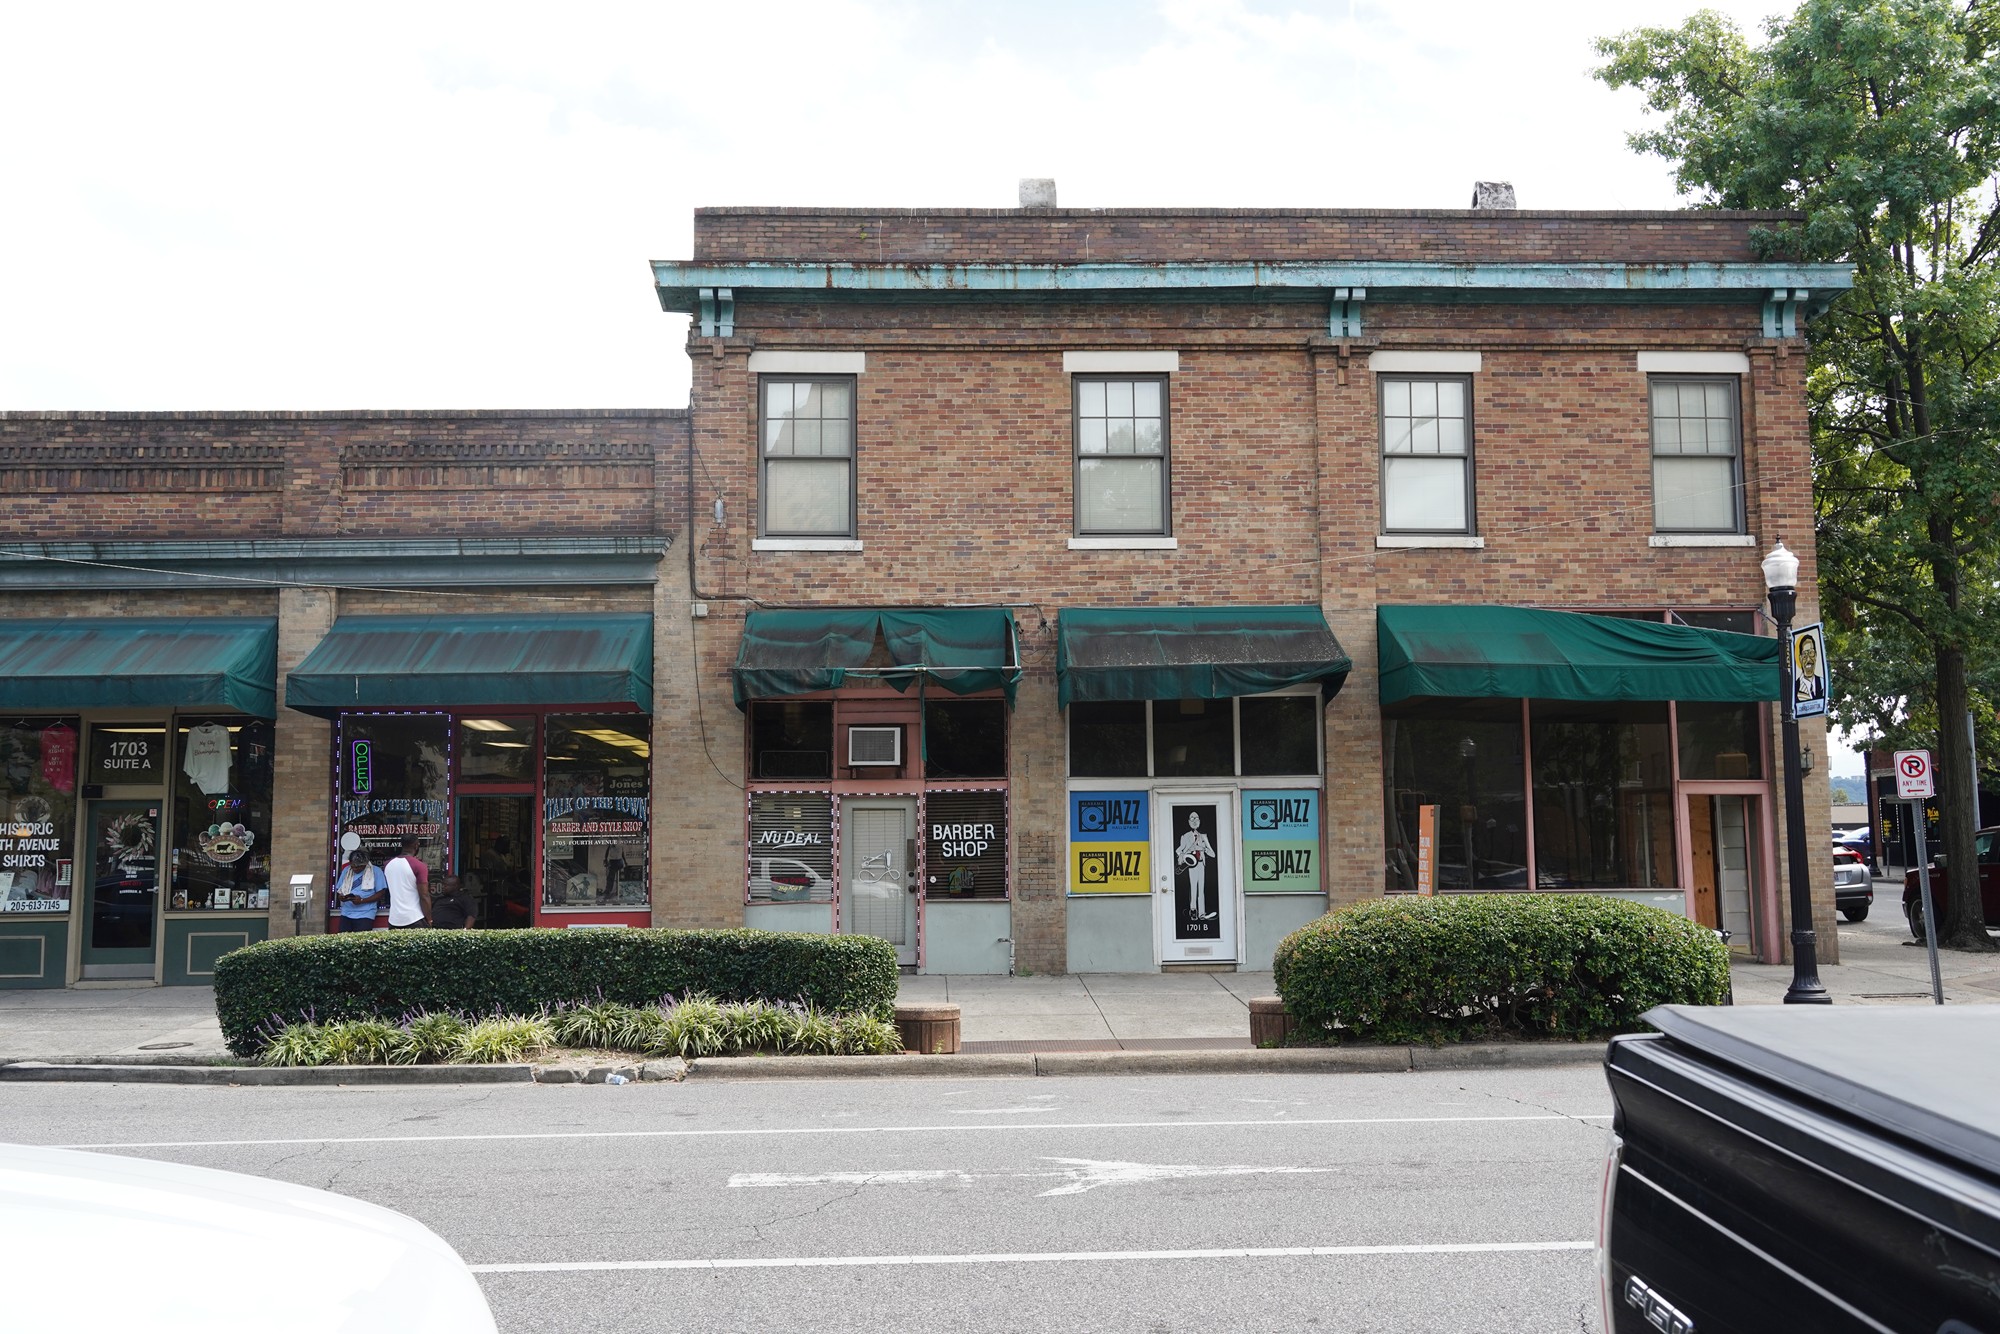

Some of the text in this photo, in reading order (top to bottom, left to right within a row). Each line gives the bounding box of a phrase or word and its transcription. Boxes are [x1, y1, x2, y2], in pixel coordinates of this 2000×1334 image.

[110, 741, 148, 756] 1703
[103, 758, 151, 769] SUITE A
[355, 743, 368, 791] OPEN
[609, 780, 643, 789] Jones
[208, 799, 241, 809] OPEN
[343, 798, 444, 825] TALK OF THE TOWN
[546, 797, 647, 823] TALK OF THE TOWN
[1270, 799, 1310, 823] JAZZ
[1099, 800, 1140, 825] JAZZ
[0, 823, 53, 835] HISTORIC
[348, 823, 440, 835] BARBER AND STYLE SHOP
[551, 821, 643, 833] BARBER AND STYLE SHOP
[932, 824, 996, 840] BARBER
[17, 839, 60, 851] AVENUE
[942, 841, 988, 857] SHOP
[3, 854, 46, 868] SHIRTS
[1099, 852, 1142, 877] JAZZ
[1271, 850, 1311, 874] JAZZ
[11, 901, 60, 912] 205-613-7145
